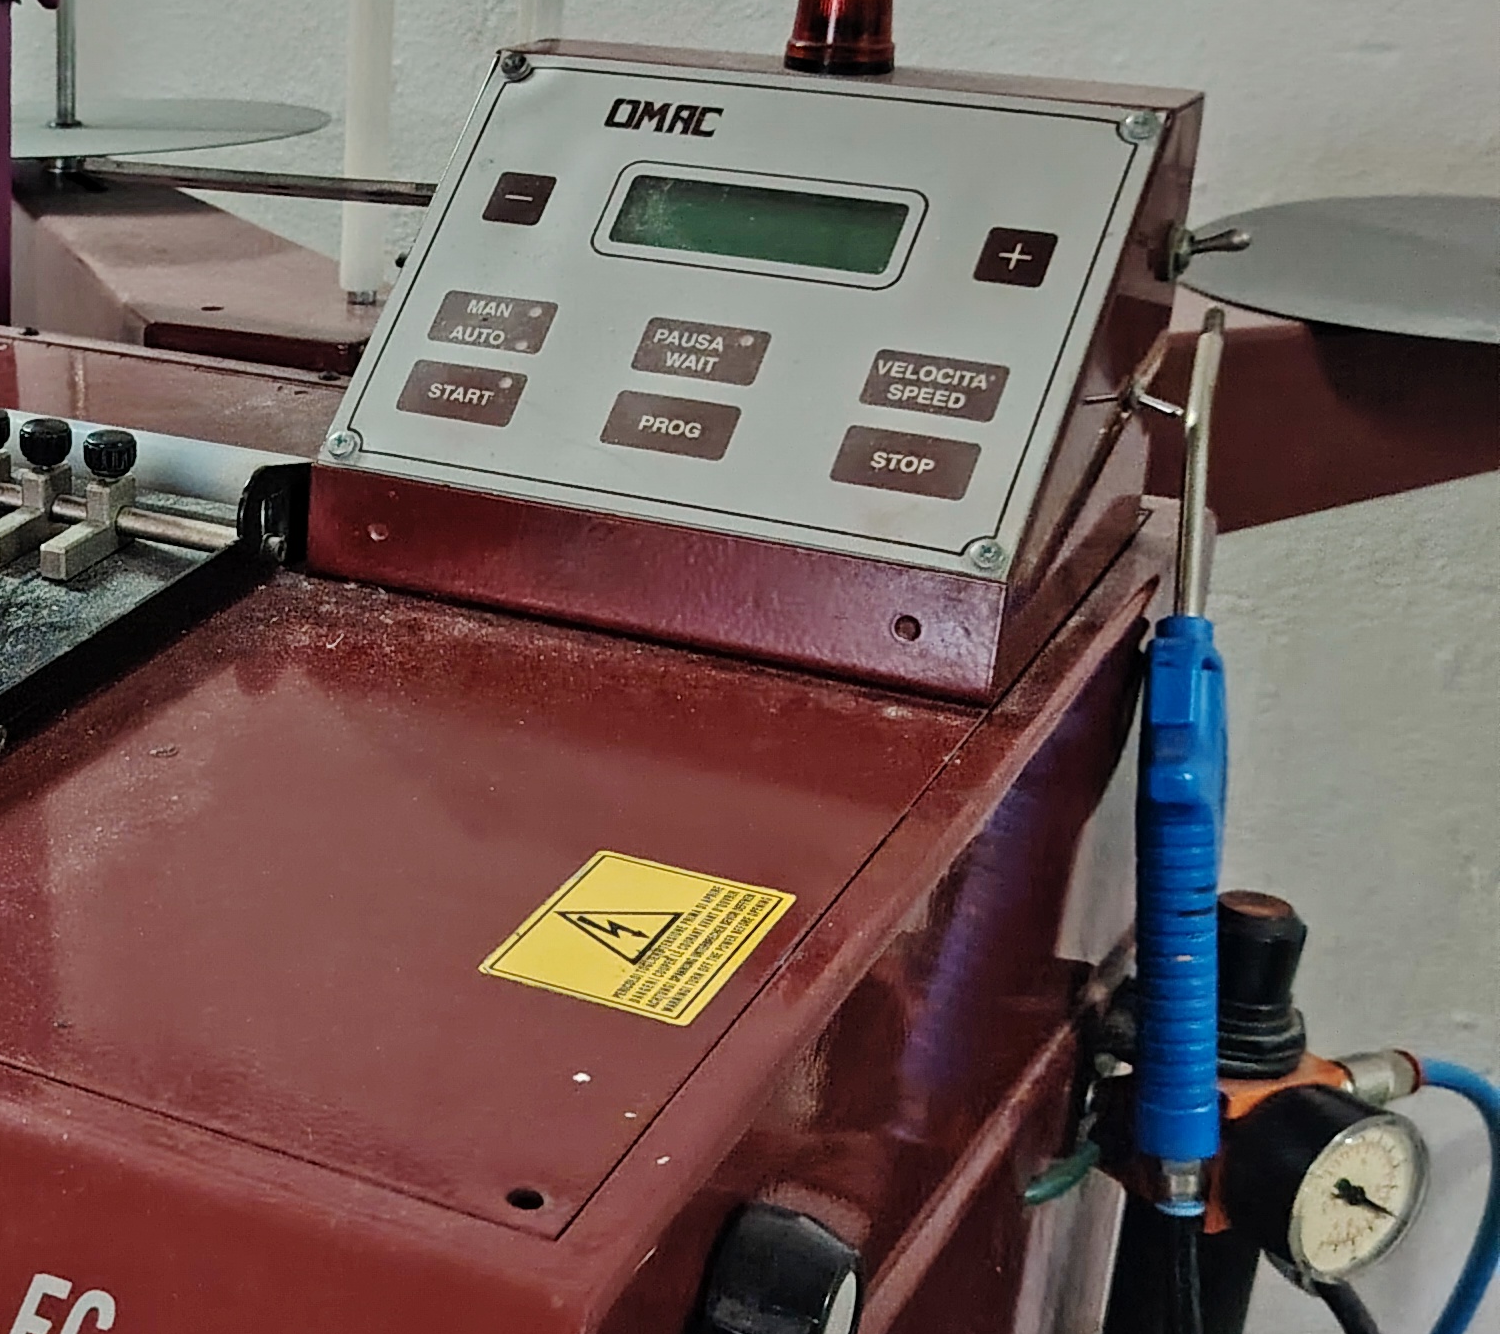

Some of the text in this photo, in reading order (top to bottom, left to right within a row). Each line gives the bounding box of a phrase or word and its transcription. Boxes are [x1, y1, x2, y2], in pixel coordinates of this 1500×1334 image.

[603, 96, 725, 139] OMAC
[466, 299, 513, 318] MAN
[449, 325, 506, 346] AUTO
[652, 328, 724, 353] PAUSA
[664, 351, 719, 373] WAIT
[427, 382, 494, 407] START
[886, 383, 966, 410] SPEED
[637, 414, 702, 439] PROG
[870, 451, 935, 475] STOP
